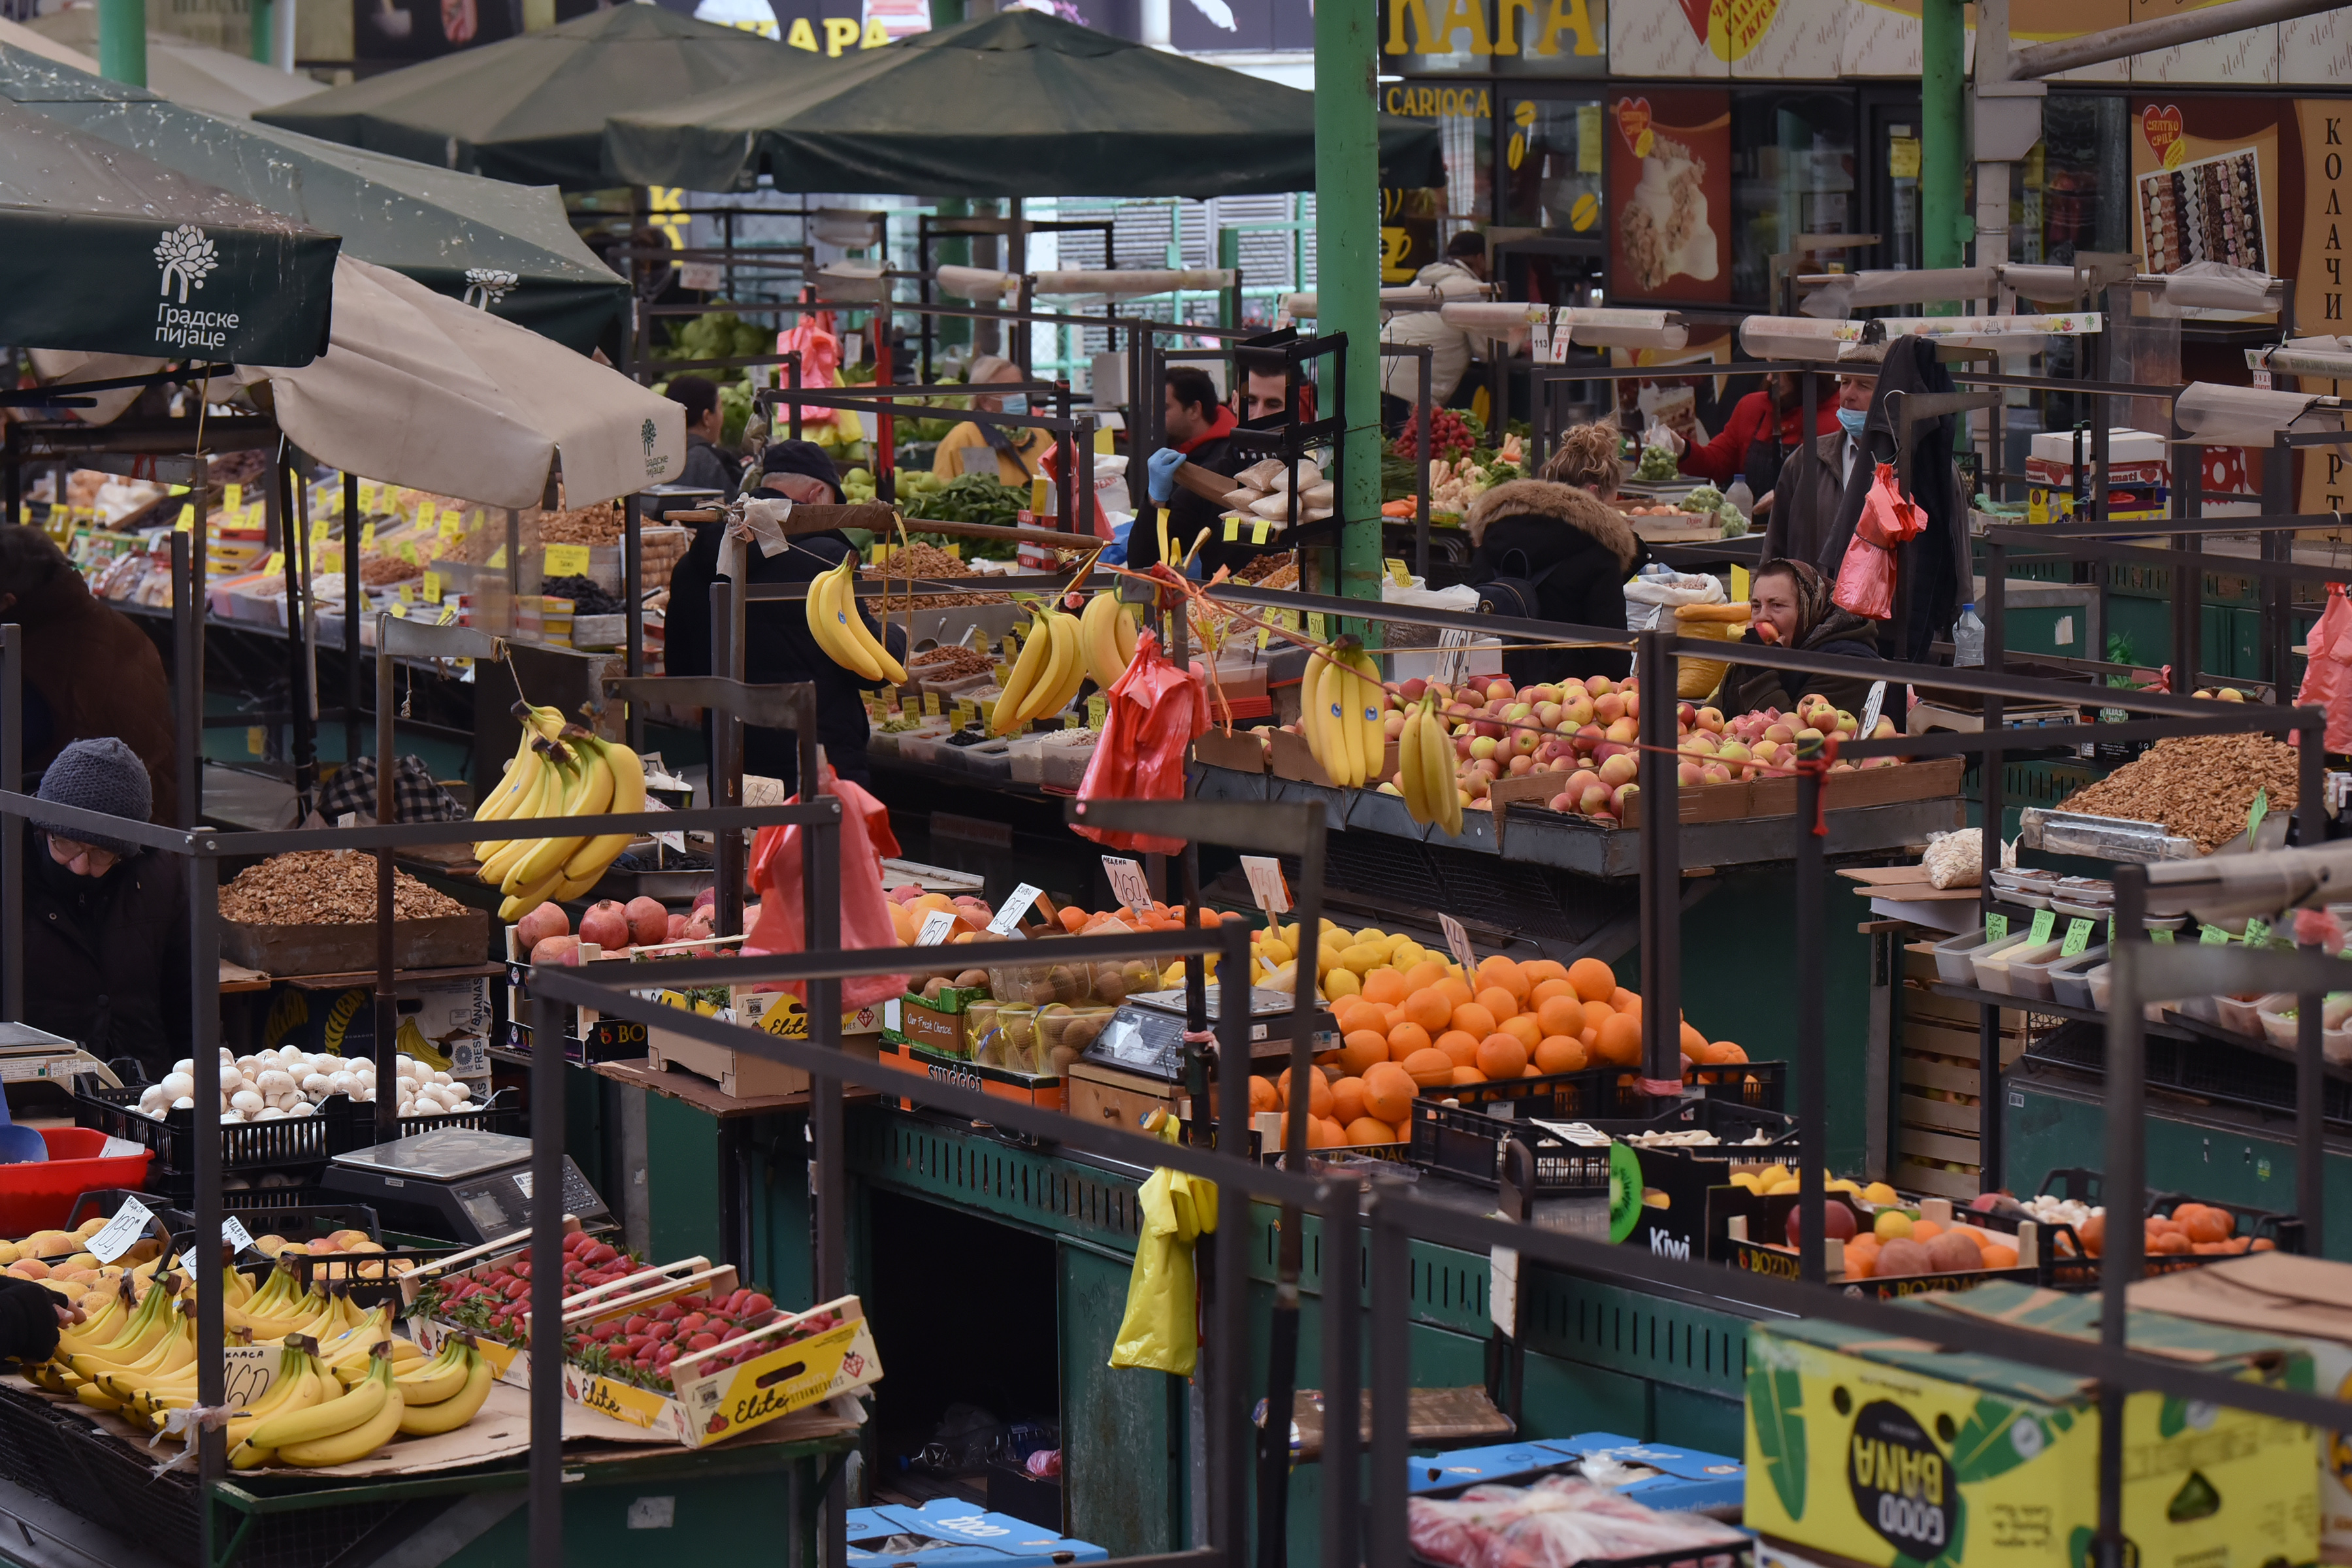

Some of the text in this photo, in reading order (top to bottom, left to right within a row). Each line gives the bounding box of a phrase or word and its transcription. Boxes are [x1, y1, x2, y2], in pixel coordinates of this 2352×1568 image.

[1386, 86, 1492, 118] CARIOCA
[2325, 118, 2342, 321] КОЛАЧИ
[157, 302, 239, 329] Градске
[155, 325, 225, 350] пијаце
[1534, 338, 1548, 348] 113
[2108, 472, 2138, 483] omati
[1310, 618, 1323, 634] 500
[2106, 707, 2123, 716] ILIAS
[1017, 885, 1033, 897] КИВИ
[2072, 920, 2087, 930] LAN
[2066, 932, 2087, 952] 250
[769, 1015, 808, 1036] Elite
[907, 1013, 917, 1025] Our
[918, 1015, 933, 1031] Fresh
[1650, 1226, 1690, 1262] Kiwi
[1751, 1249, 1801, 1282] BOZDA
[225, 1350, 264, 1358] КЛАСА
[582, 1377, 621, 1413] Elite
[734, 1388, 790, 1424] Elite
[1853, 1434, 1943, 1505] BANA
[1878, 1493, 1945, 1546] GOOD
